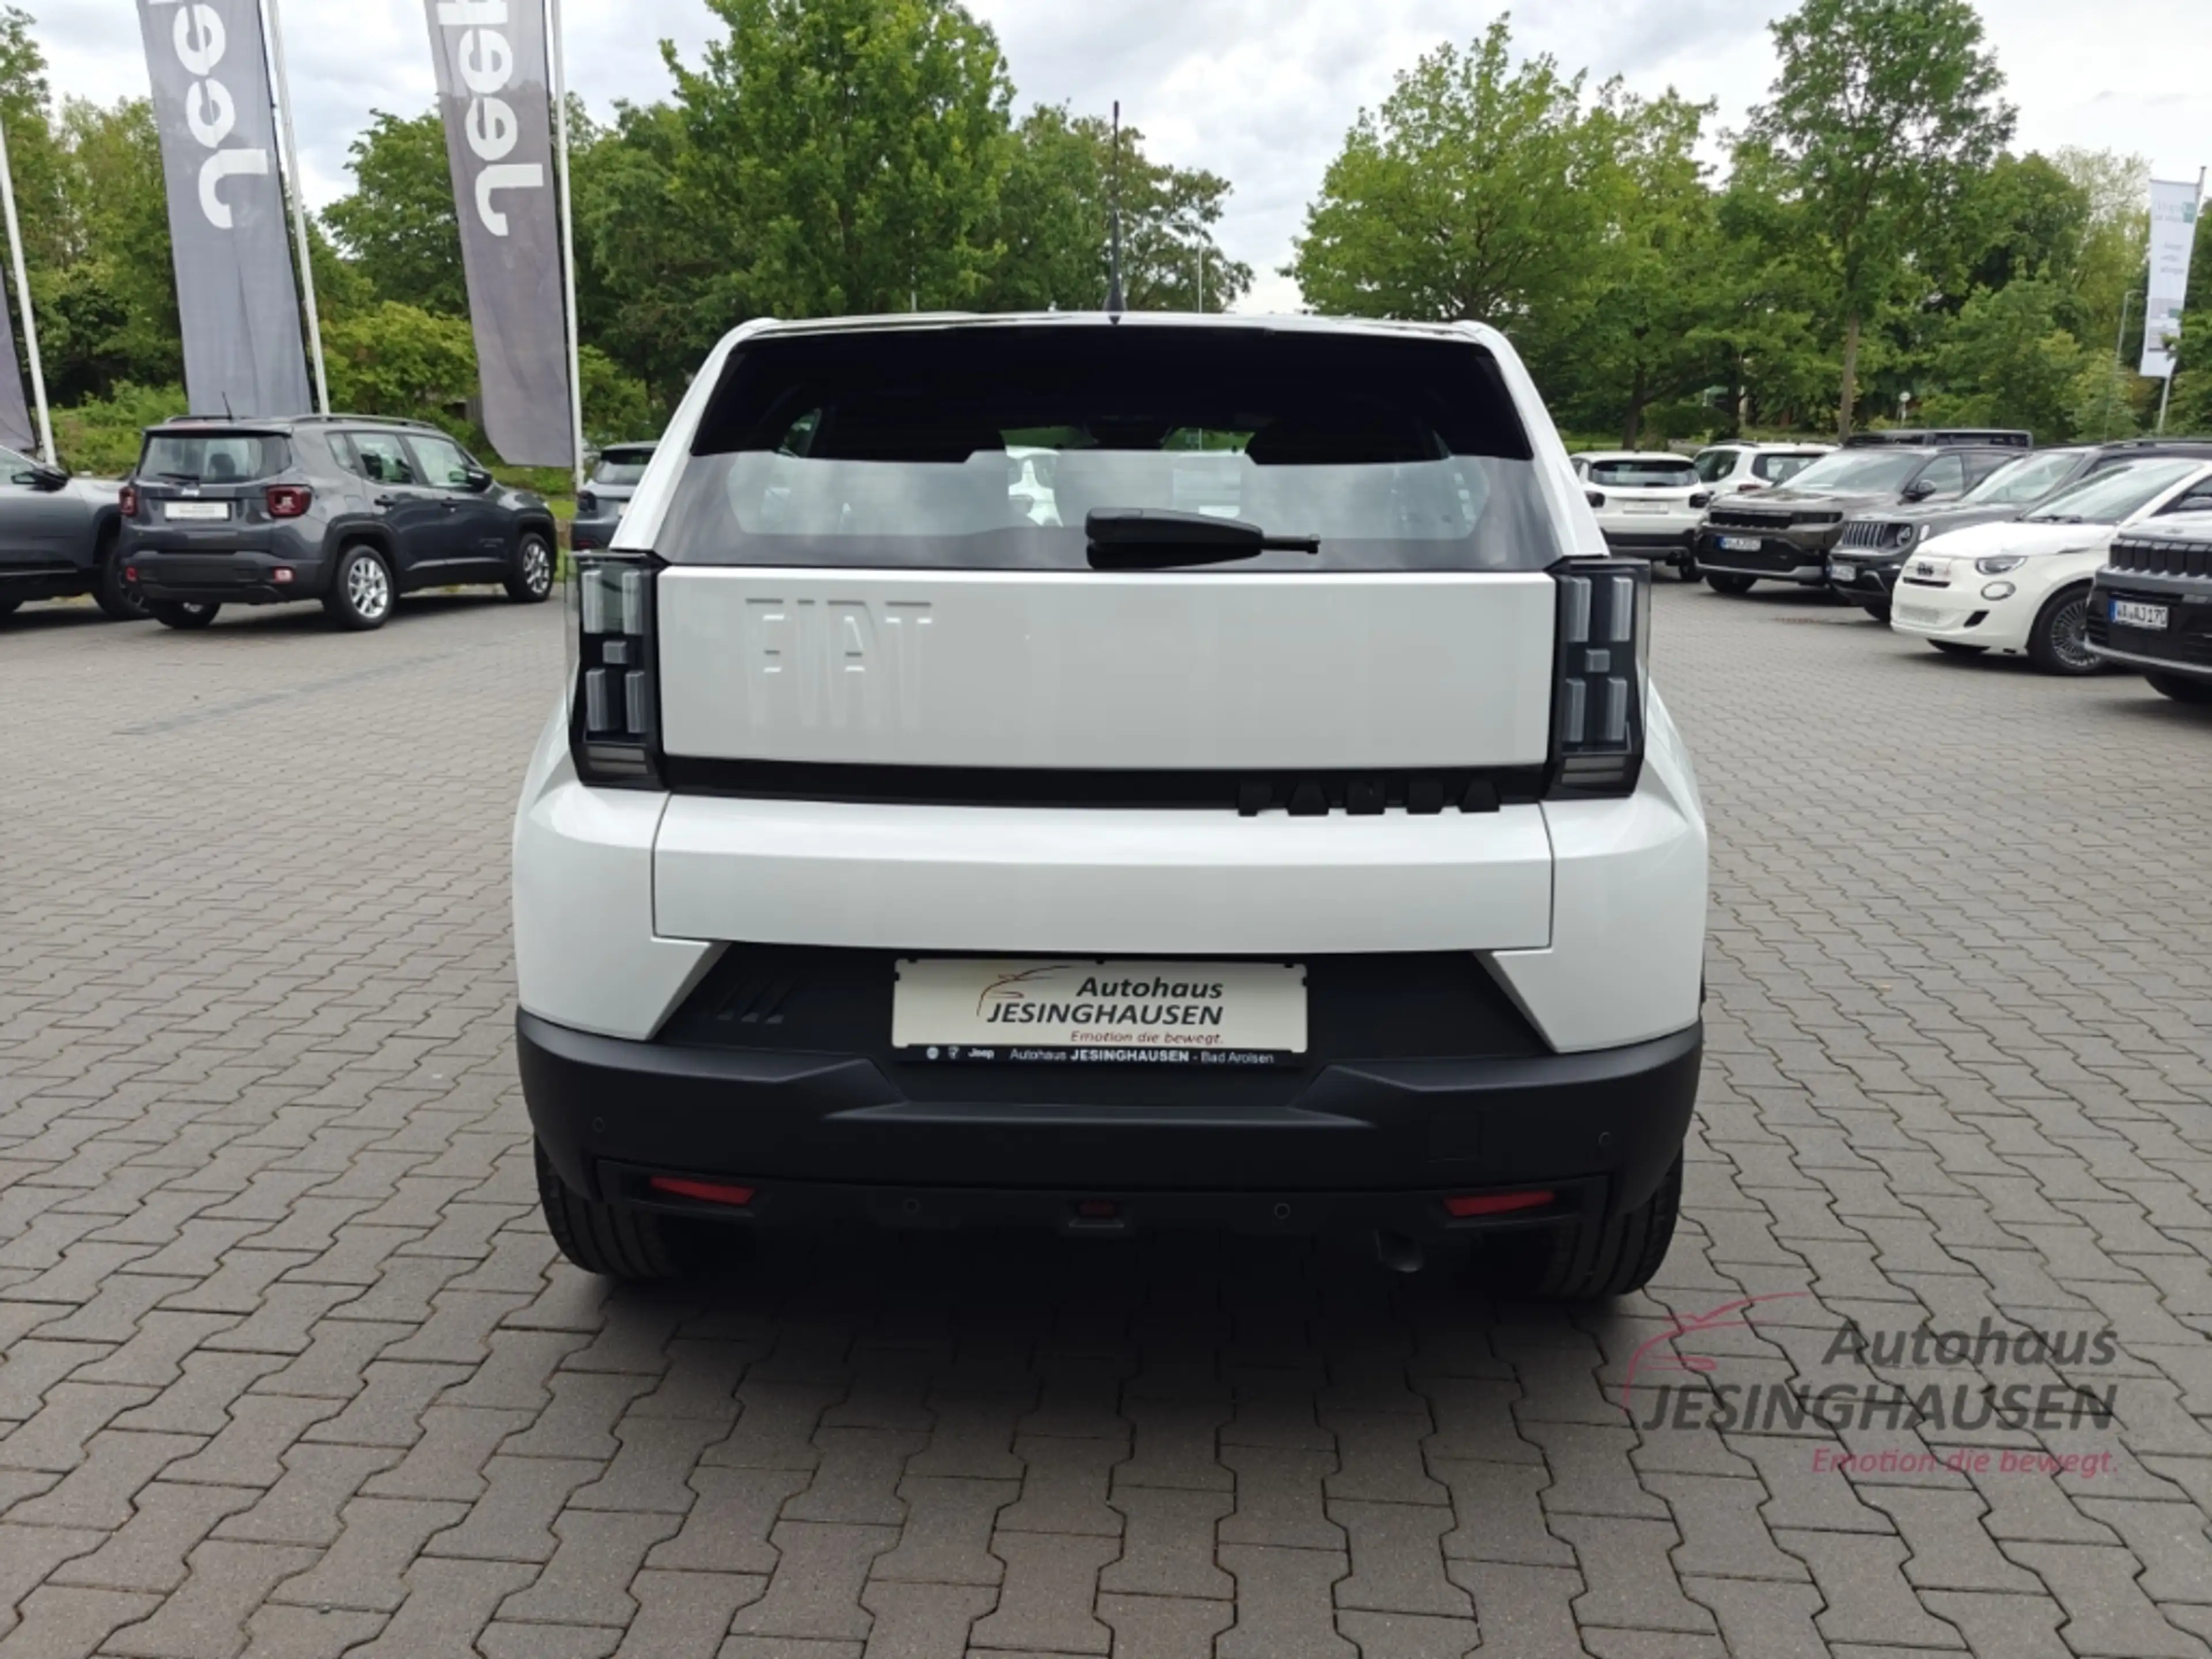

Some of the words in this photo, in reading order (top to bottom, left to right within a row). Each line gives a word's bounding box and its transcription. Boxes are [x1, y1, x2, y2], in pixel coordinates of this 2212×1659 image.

[147, 0, 268, 229] Jee
[745, 597, 934, 730] FIAT
[1076, 976, 1224, 999] Autohaus
[987, 1002, 1224, 1025] JESINGHAUSEN
[1070, 1029, 1134, 1043] Emotion
[1137, 1031, 1160, 1043] die
[1164, 1032, 1224, 1046] bewegt.
[968, 1048, 995, 1059] Jeep
[1009, 1048, 1067, 1061] Autohaus
[1070, 1048, 1190, 1062] JESINGHAUSEN
[1200, 1051, 1228, 1063] Bad
[1228, 1052, 1274, 1064] Arolsen
